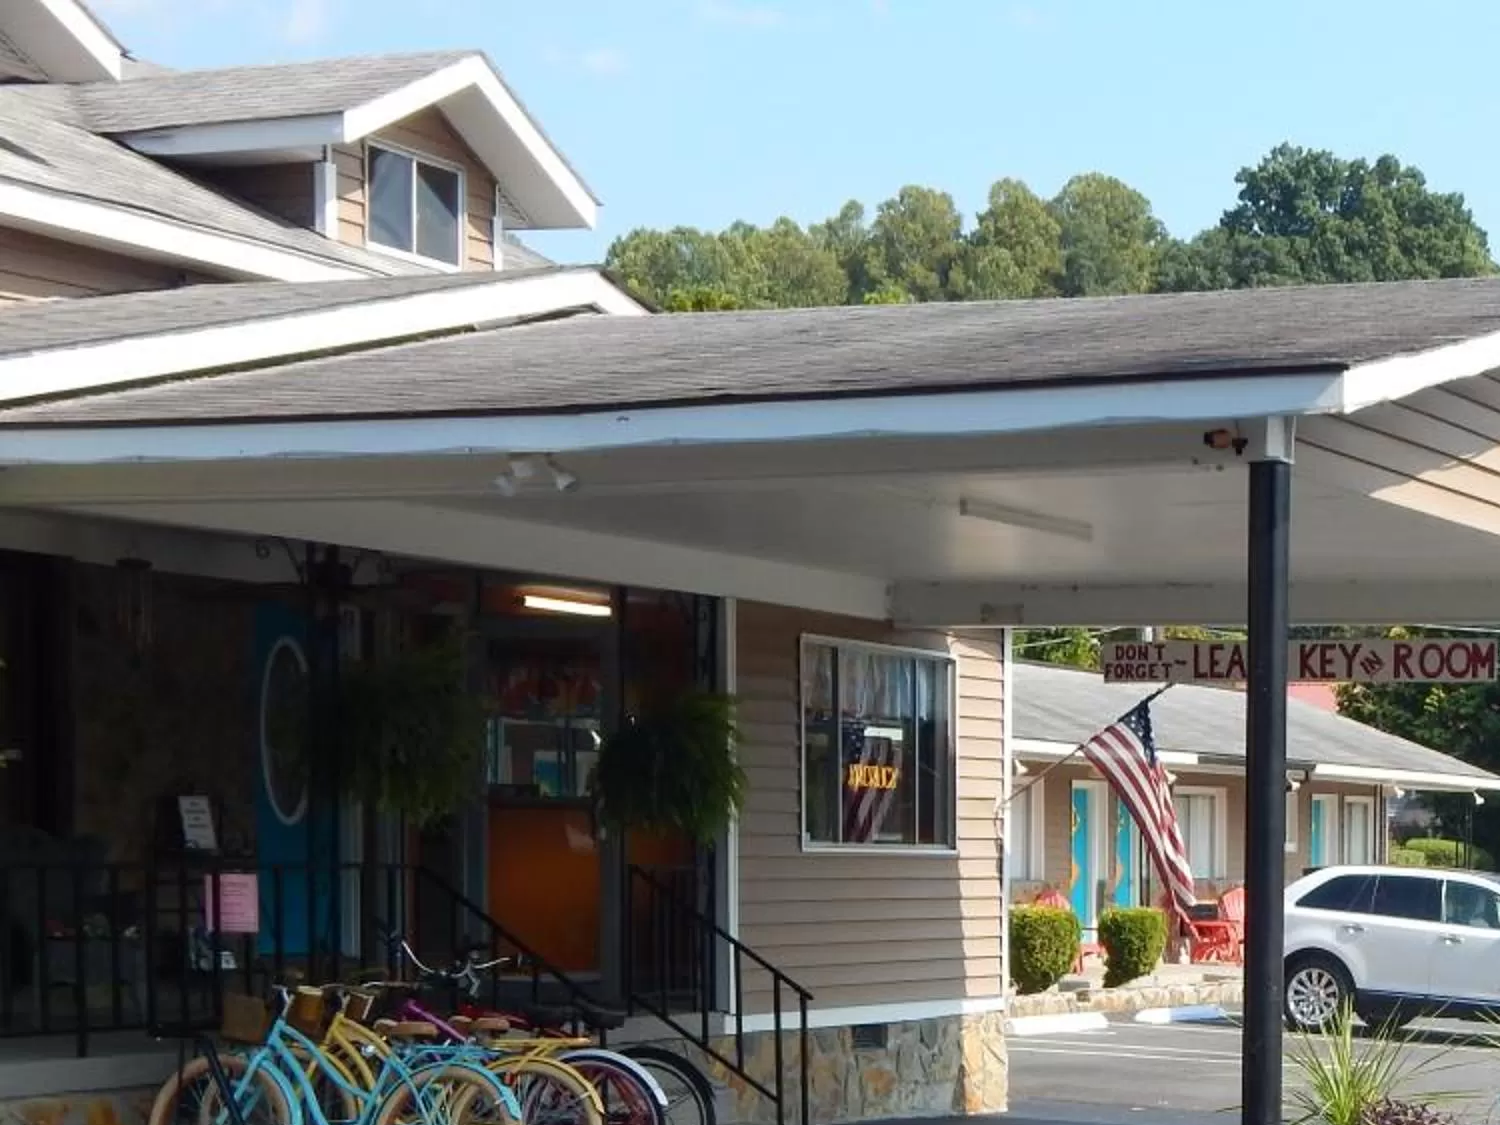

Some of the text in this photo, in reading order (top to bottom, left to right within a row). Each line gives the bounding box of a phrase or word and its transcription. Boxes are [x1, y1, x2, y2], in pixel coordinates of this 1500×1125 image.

[1104, 663, 1173, 679] FORGET
[1194, 643, 1247, 679] LEA
[1299, 643, 1362, 679] KEY
[1359, 649, 1385, 676] IN
[1393, 642, 1495, 679] ROOM
